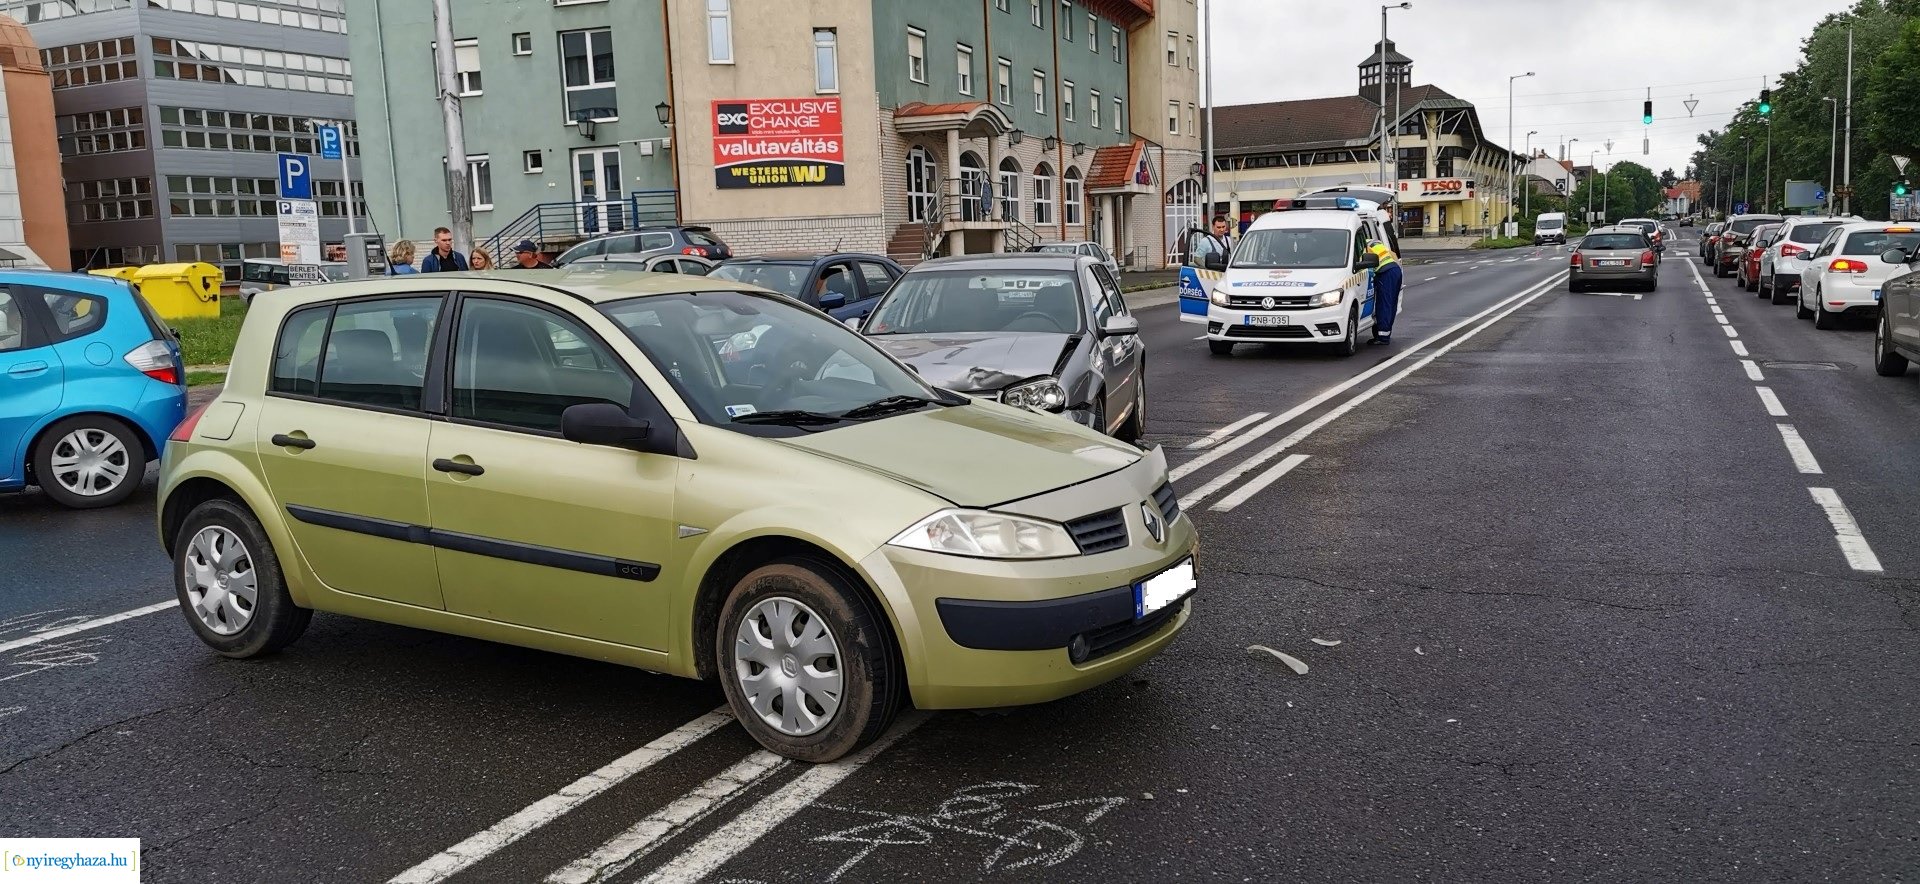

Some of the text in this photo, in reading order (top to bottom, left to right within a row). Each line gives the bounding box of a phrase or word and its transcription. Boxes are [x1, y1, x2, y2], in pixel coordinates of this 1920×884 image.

[749, 102, 837, 115] EXCLUSIVE
[717, 112, 749, 126] exc
[750, 116, 820, 129] CHANGE
[322, 128, 337, 149] P
[718, 138, 839, 156] valutaváltás
[286, 158, 304, 189] P
[731, 166, 788, 176] WESTERN
[794, 165, 826, 183] WU
[750, 174, 788, 184] UNION
[1421, 180, 1463, 192] TESCO
[281, 202, 290, 214] P
[1250, 316, 1287, 325] PNB-035
